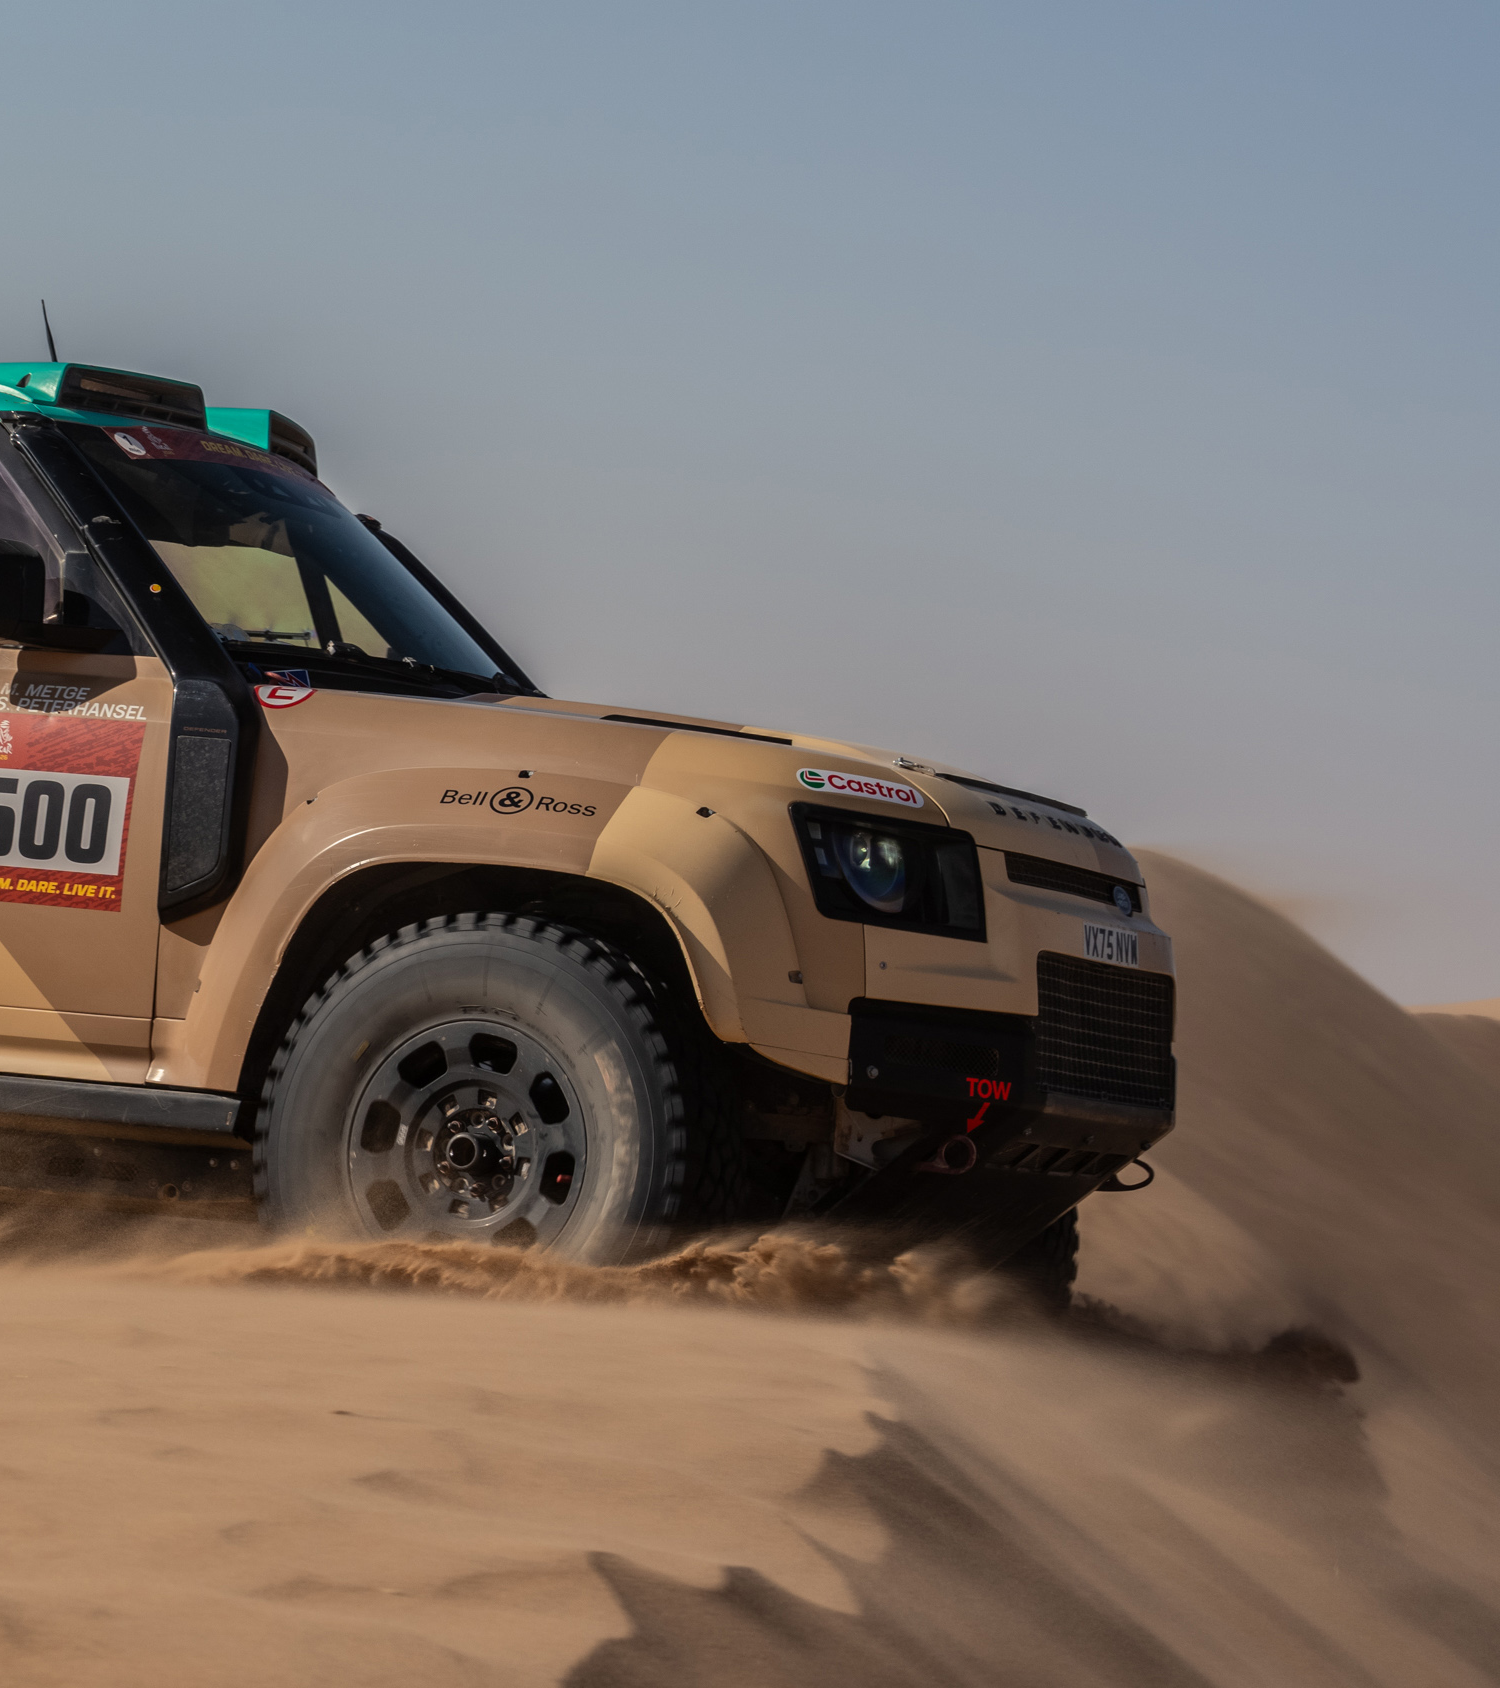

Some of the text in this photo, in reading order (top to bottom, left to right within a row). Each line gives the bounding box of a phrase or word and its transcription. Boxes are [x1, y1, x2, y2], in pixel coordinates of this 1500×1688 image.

[122, 435, 133, 446] 1
[200, 440, 247, 458] DREAM.
[0, 683, 90, 701] M. METGE
[16, 698, 147, 720] PETERHANSEL
[827, 774, 918, 804] Castrol
[439, 789, 488, 806] Bell
[535, 796, 597, 817] Ross
[16, 879, 60, 894] DARE.
[63, 883, 97, 897] LIVE
[98, 886, 116, 899] IT.
[1084, 924, 1138, 965] VX75 NVW
[966, 1077, 1012, 1101] TOW
